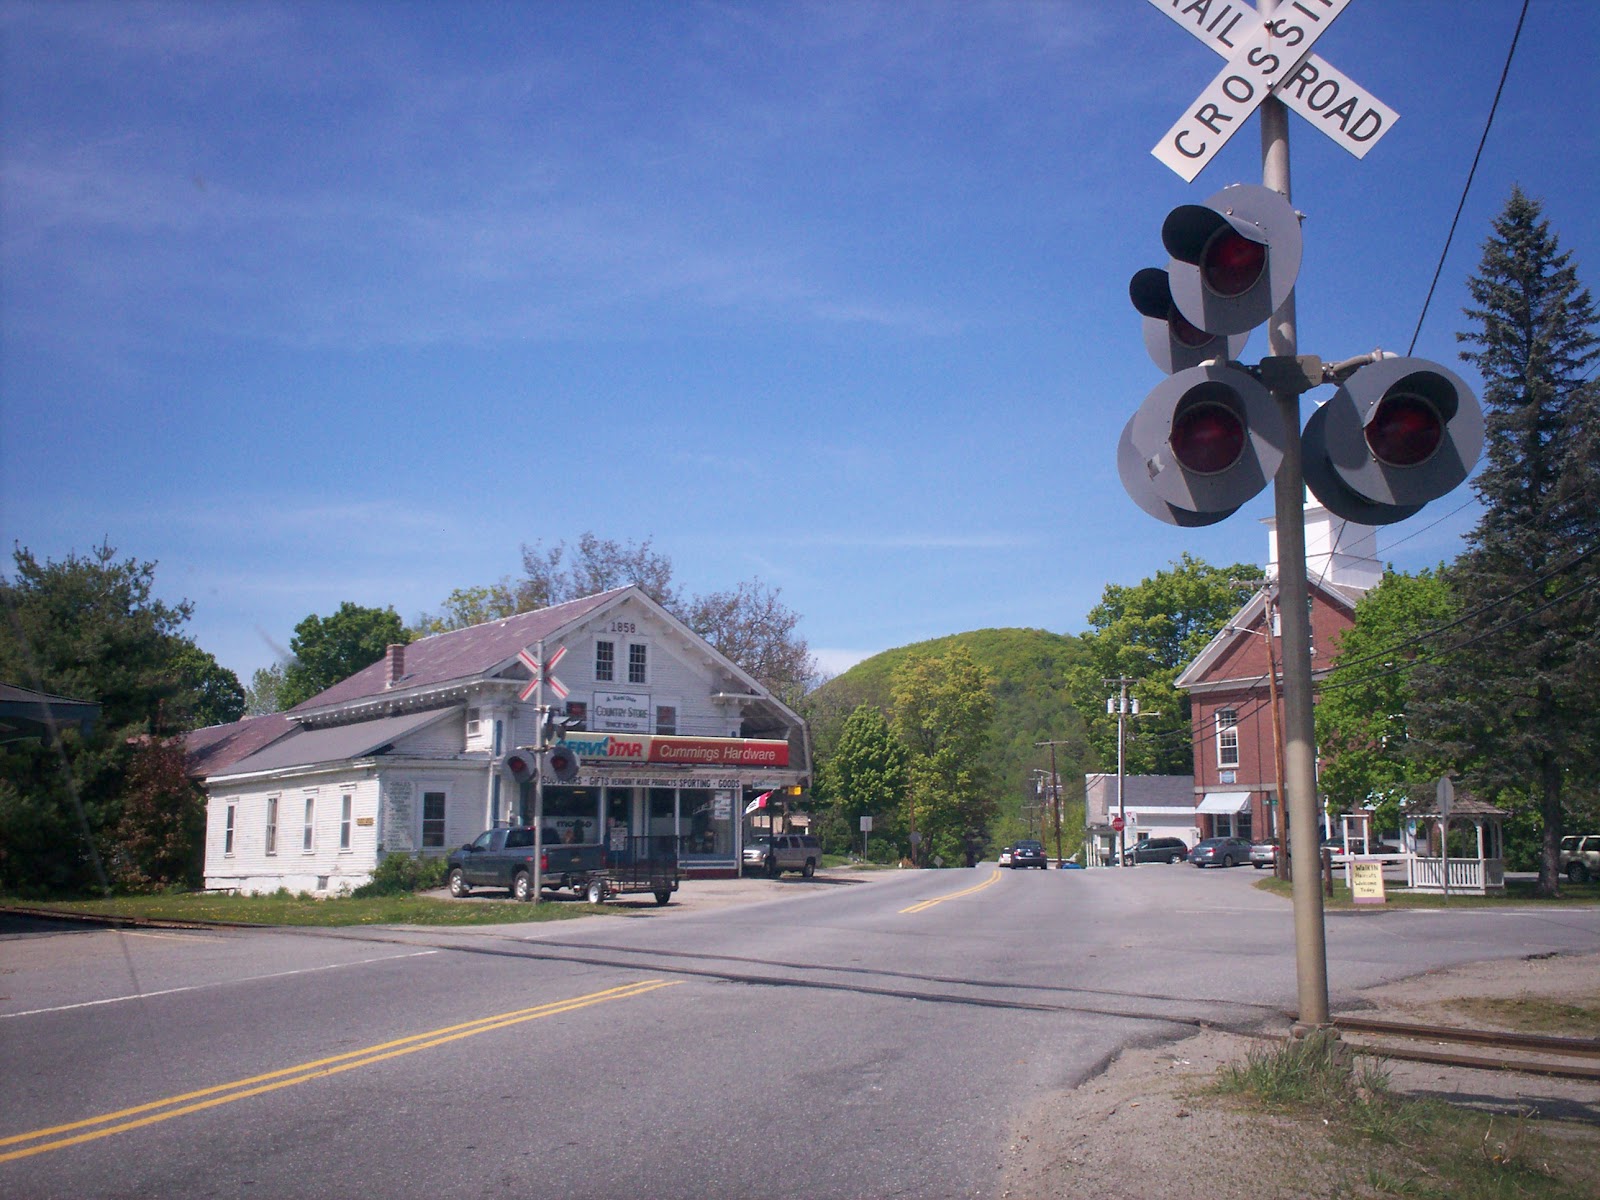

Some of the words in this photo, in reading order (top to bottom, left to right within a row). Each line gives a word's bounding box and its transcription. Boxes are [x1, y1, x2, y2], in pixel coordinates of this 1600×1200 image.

[1170, 0, 1243, 49] AIL
[1283, 61, 1382, 142] ROAD
[611, 621, 636, 633] 1858
[596, 705, 627, 717] COUNTRY
[628, 707, 648, 718] STORE
[659, 744, 719, 761] Cummings
[723, 746, 776, 760] Hardware
[589, 776, 609, 785] GIFTS
[680, 779, 711, 788] SPORTING
[718, 779, 740, 788] GOODS
